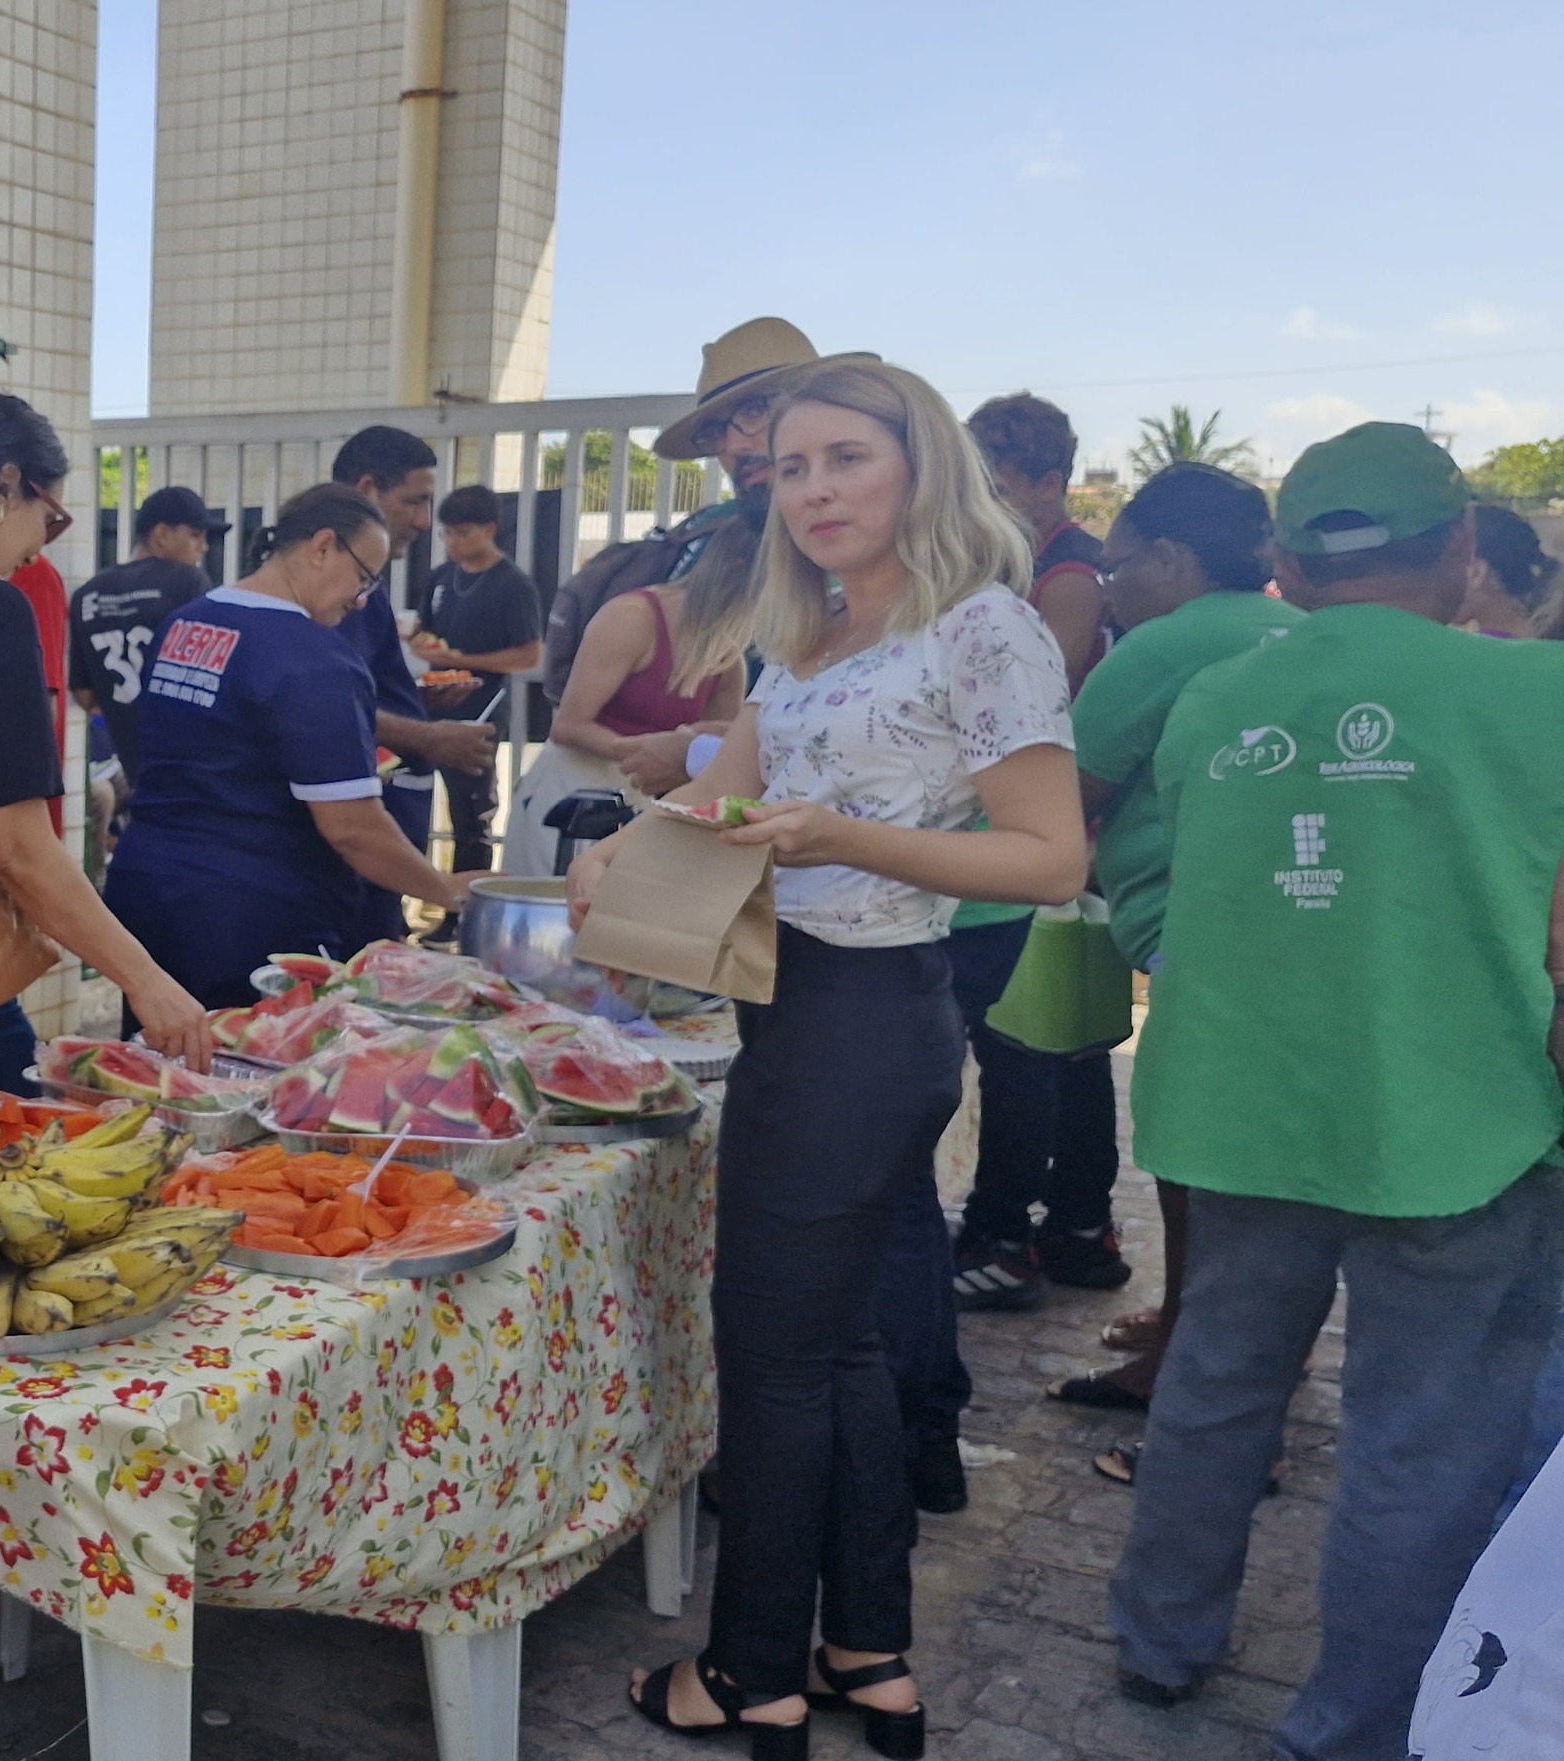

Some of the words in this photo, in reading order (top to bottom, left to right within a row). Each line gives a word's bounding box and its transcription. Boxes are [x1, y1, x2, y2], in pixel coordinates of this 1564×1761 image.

[157, 618, 241, 675] ALERTA
[1235, 743, 1284, 768] CPT
[1274, 868, 1344, 885] INSTITUTO
